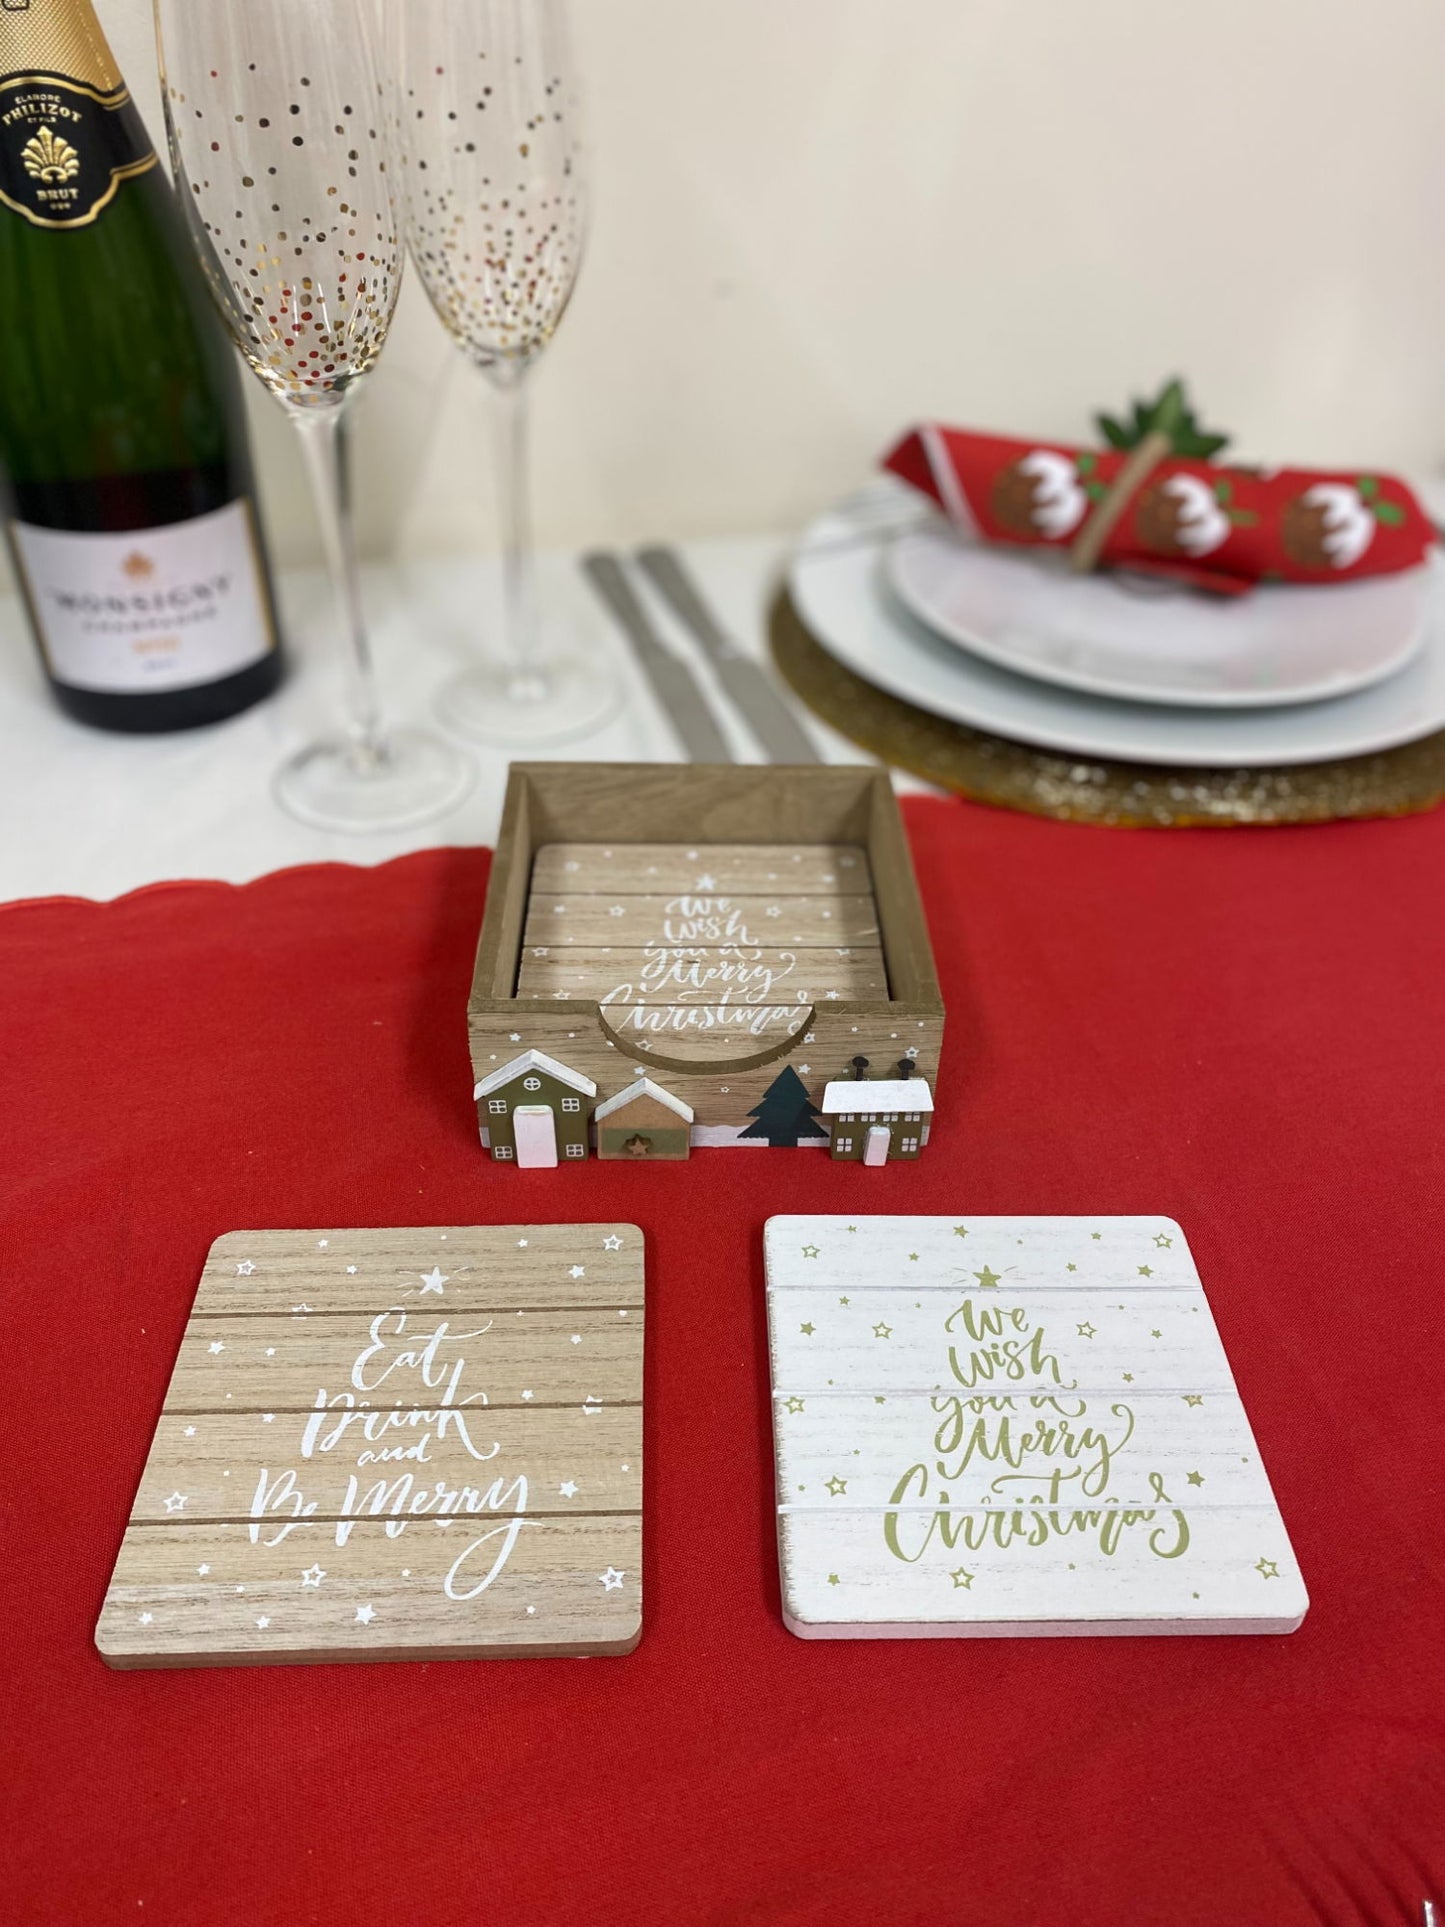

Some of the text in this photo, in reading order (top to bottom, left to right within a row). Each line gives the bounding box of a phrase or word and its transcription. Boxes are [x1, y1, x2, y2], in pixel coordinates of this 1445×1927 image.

[2, 103, 82, 126] PHILIZOT
[36, 189, 78, 200] BRUT
[640, 940, 708, 979] you
[640, 951, 797, 1004] Merry
[351, 1306, 493, 1391] Eat
[301, 1358, 500, 1460] Drink
[930, 1384, 1017, 1454] you
[357, 1433, 432, 1467] and
[936, 1403, 1135, 1497] Merry
[248, 1468, 546, 1600] Be Merry
[883, 1463, 1191, 1564] Christmas
